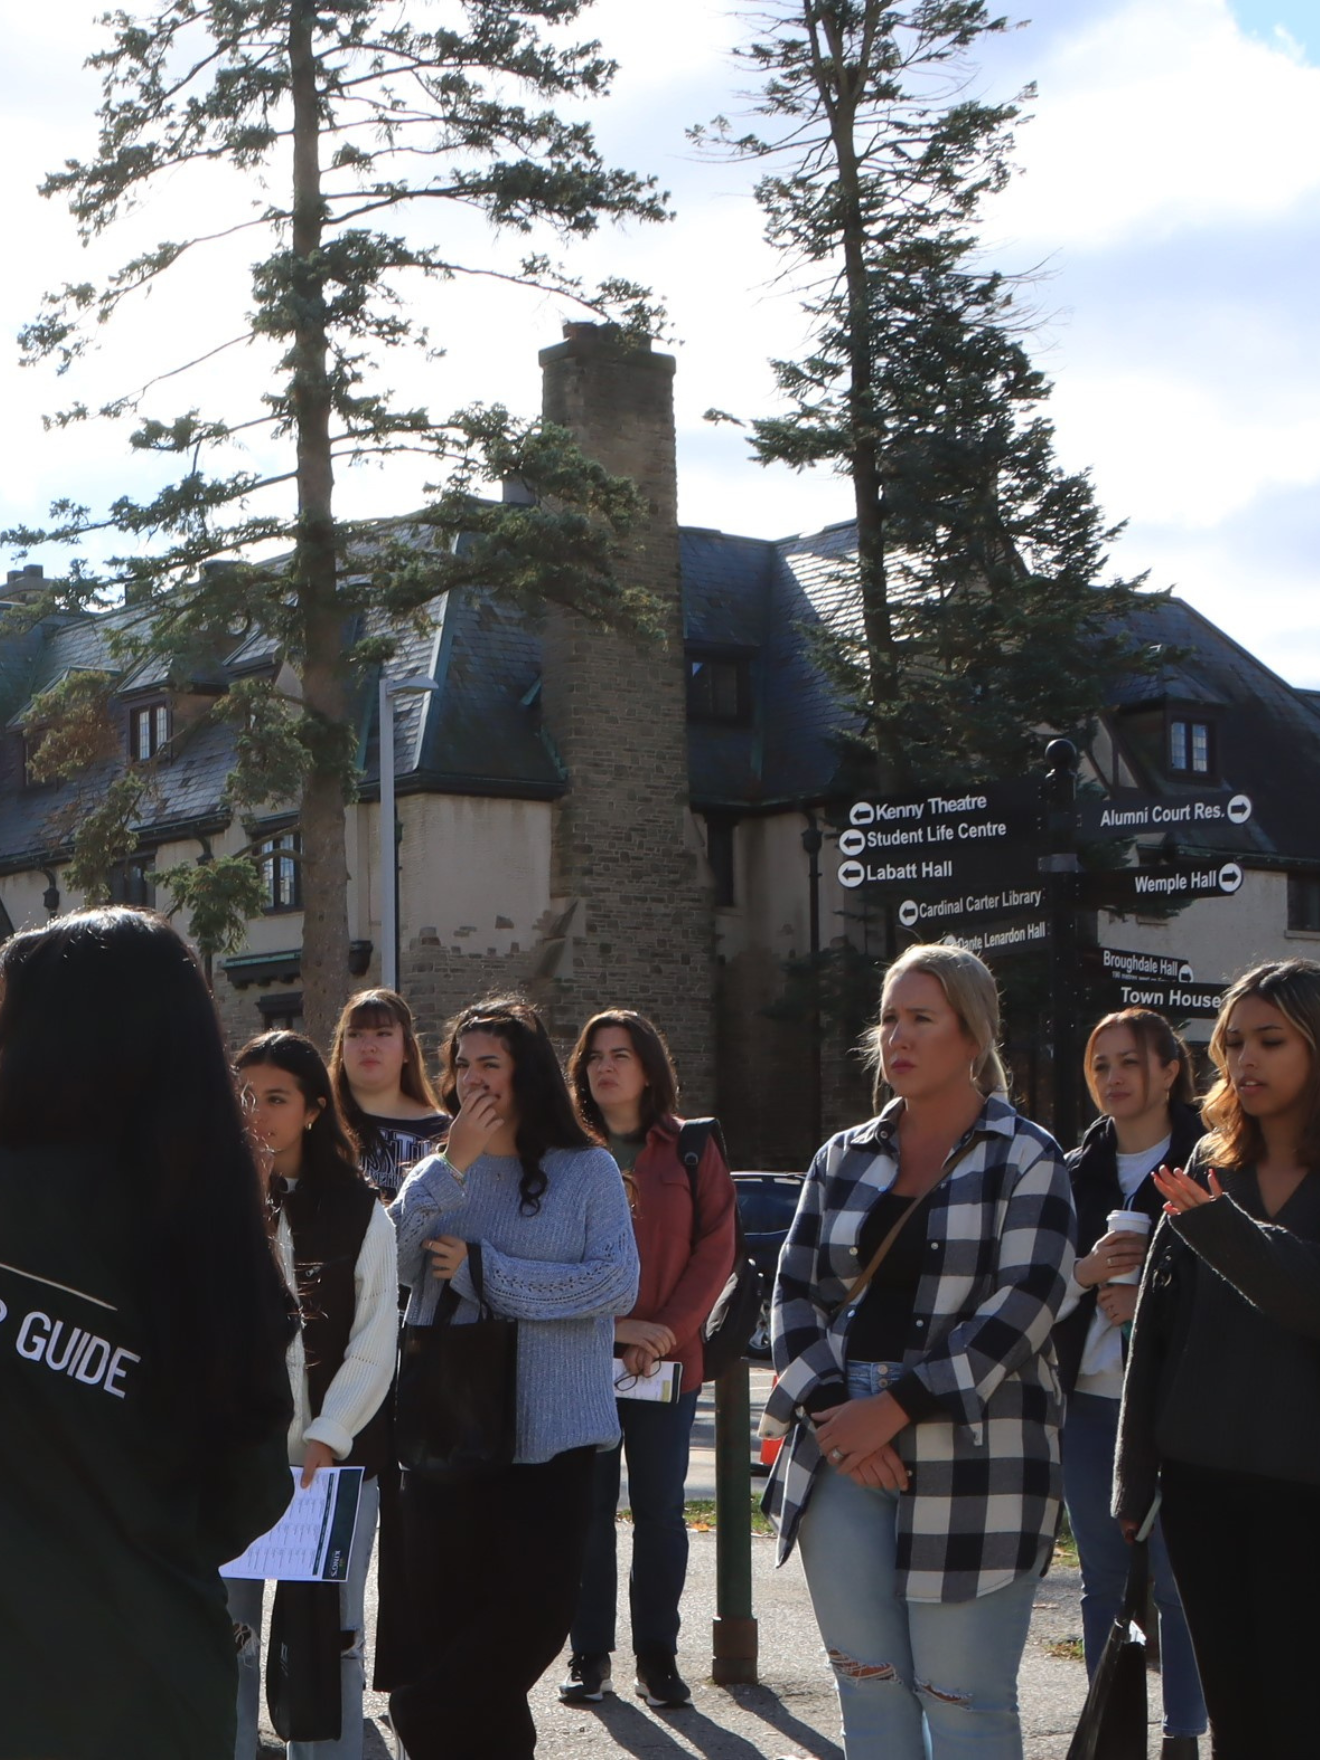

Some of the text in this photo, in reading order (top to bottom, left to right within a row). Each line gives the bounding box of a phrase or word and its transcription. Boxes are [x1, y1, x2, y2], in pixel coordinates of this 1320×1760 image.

[876, 795, 987, 820] Kenny Theatre
[1100, 802, 1225, 827] Alumni Court Res.
[867, 821, 1007, 848] Student Life Centre
[866, 860, 953, 881] Labatt Hall
[1135, 870, 1217, 894] Wemple Hall
[919, 889, 1042, 918] Cardinal Carter Library
[984, 927, 1025, 948] Lenardon
[1027, 921, 1046, 939] Hall
[1103, 950, 1178, 976] Broughdale Hall
[1120, 986, 1164, 1005] Town
[15, 1310, 142, 1399] GUIDE
